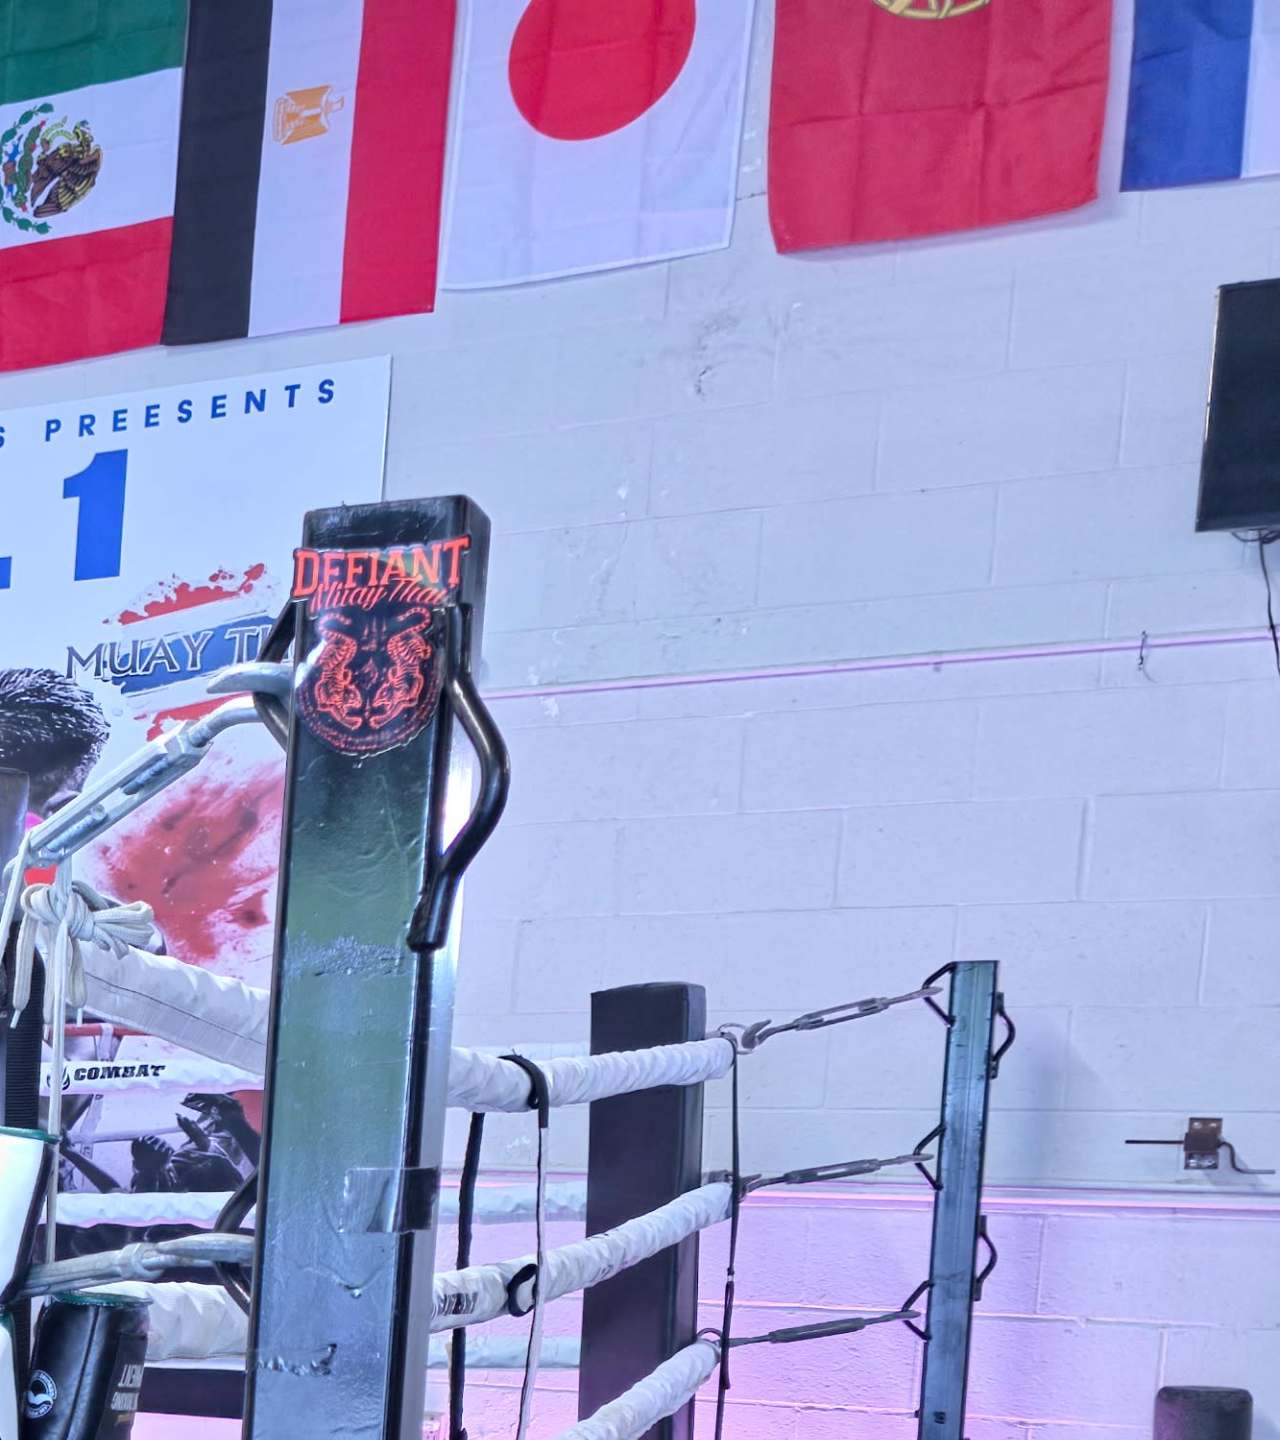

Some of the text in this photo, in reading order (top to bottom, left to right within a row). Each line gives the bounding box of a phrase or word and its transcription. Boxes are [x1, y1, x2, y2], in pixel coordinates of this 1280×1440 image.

[44, 378, 335, 442] PREESENTS
[62, 448, 128, 582] 1
[293, 538, 470, 597] DEFIANT
[67, 628, 214, 682] MUAY
[74, 1065, 165, 1081] COMBAT
